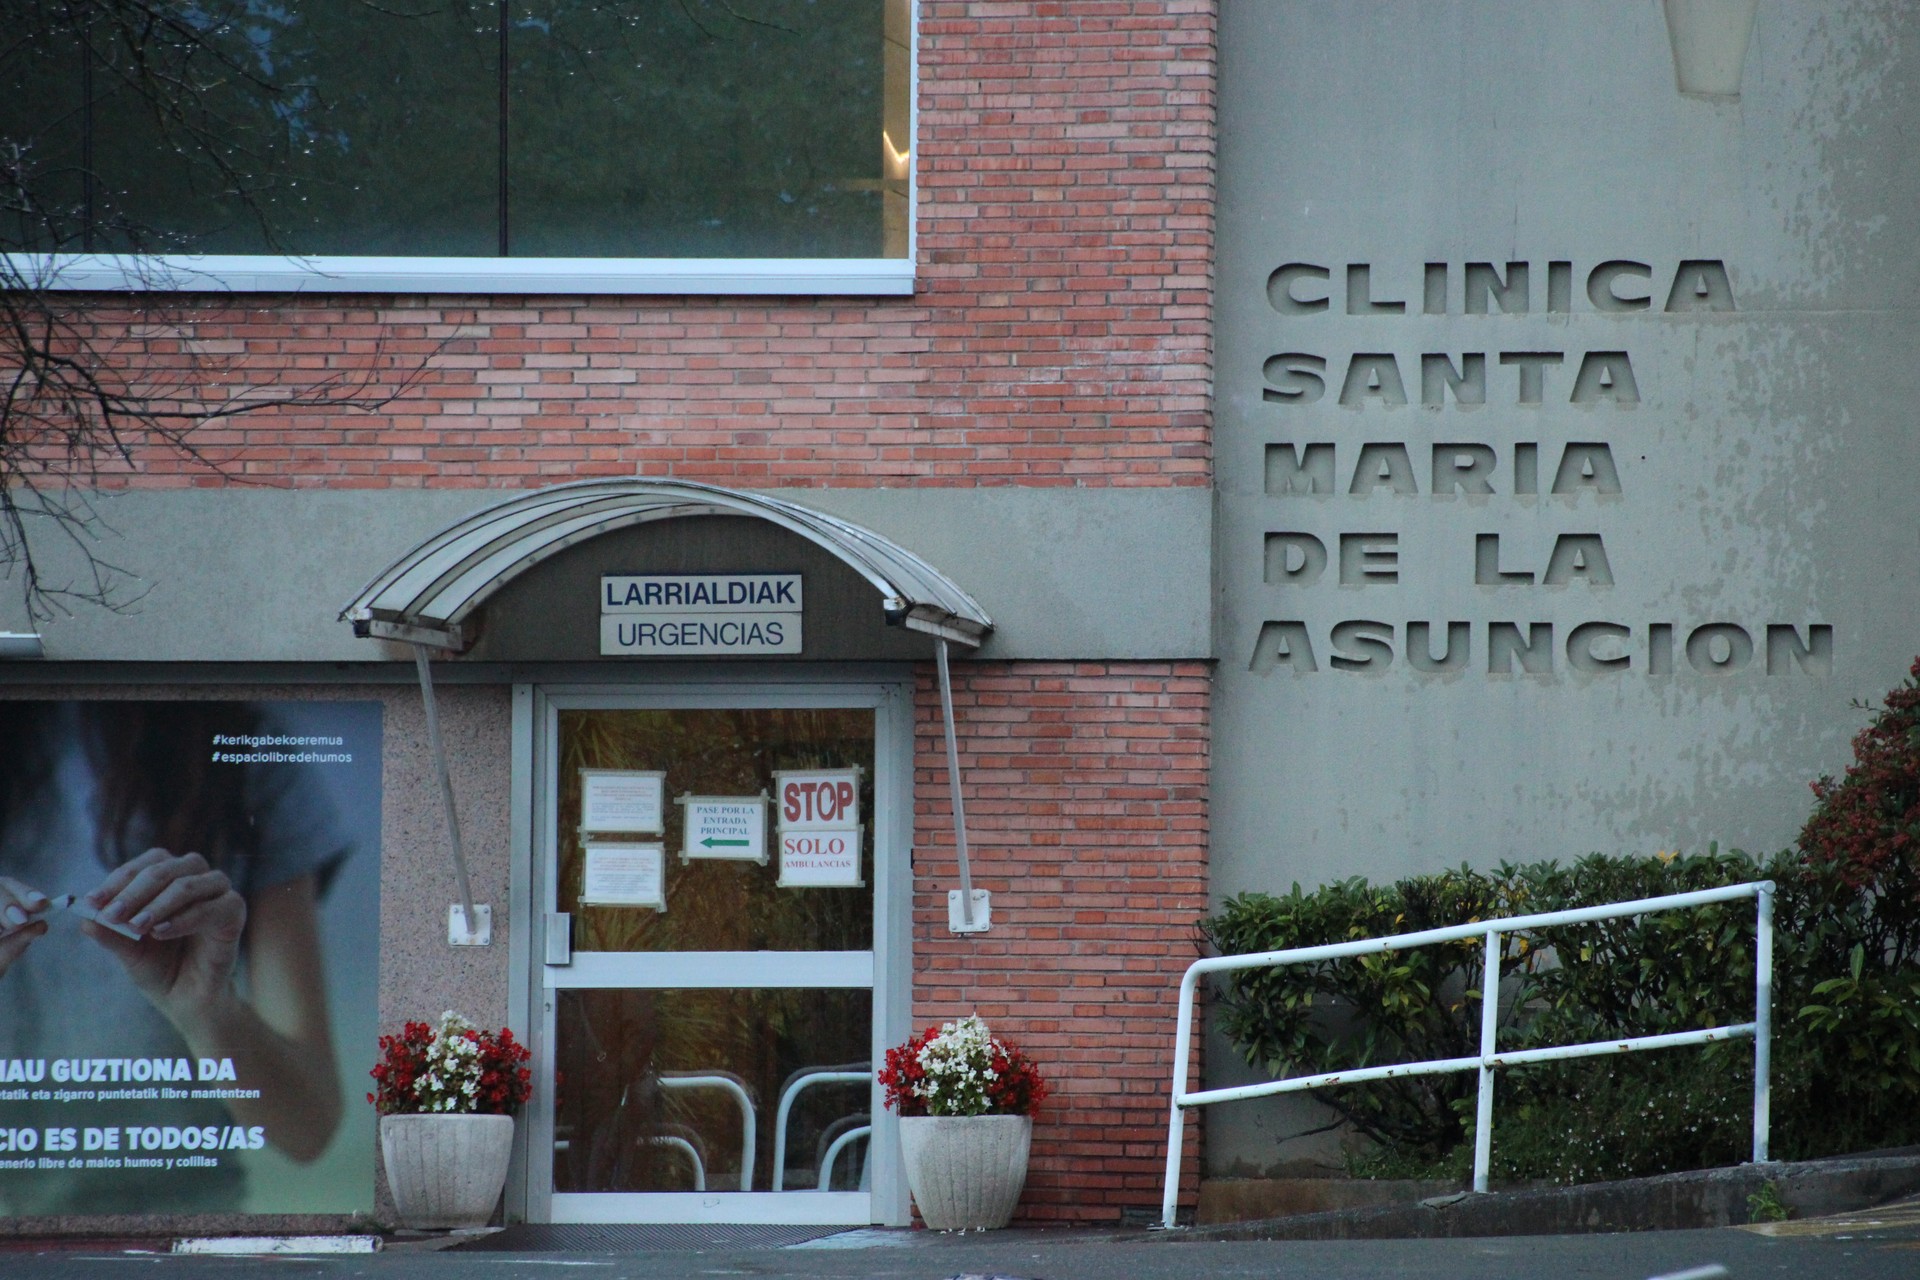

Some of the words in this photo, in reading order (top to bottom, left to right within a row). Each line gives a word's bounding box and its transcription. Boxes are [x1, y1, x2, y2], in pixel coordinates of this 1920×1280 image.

[1266, 259, 1736, 316] CLINICA
[1262, 350, 1641, 404] SANTA
[1264, 442, 1622, 495] MARIA
[1263, 531, 1399, 585] DE
[1475, 533, 1615, 585] LA
[607, 581, 796, 605] LARRIALDIAK
[618, 622, 784, 646] URGENCIAS
[1248, 620, 1833, 676] ASUNCION
[212, 751, 352, 764] #espaciolibredehumos
[697, 806, 719, 814] PASE
[721, 806, 740, 814] POR
[742, 807, 755, 815] LA
[784, 781, 854, 822] STOP
[700, 827, 750, 835] PRINCIPAL
[703, 817, 747, 825] ENTRADA
[784, 838, 845, 855] SOLO
[784, 860, 851, 868] AMBULANCIAS
[51, 1058, 192, 1082] GUZTIONA
[198, 1058, 237, 1081] DA
[0, 1088, 29, 1100] tatik
[31, 1090, 51, 1100] eta
[53, 1089, 95, 1102] zigarro
[98, 1088, 159, 1102] puntetatik
[161, 1088, 188, 1099] libre
[191, 1088, 260, 1099] mantentzen
[44, 1127, 77, 1151] ES
[83, 1127, 120, 1151] DE
[125, 1126, 265, 1150] TODOS/AS
[38, 1157, 65, 1168] libre
[68, 1157, 83, 1168] de
[85, 1157, 122, 1168] malos
[124, 1157, 163, 1168] humos
[165, 1159, 174, 1170] y
[176, 1155, 218, 1167] colillas
